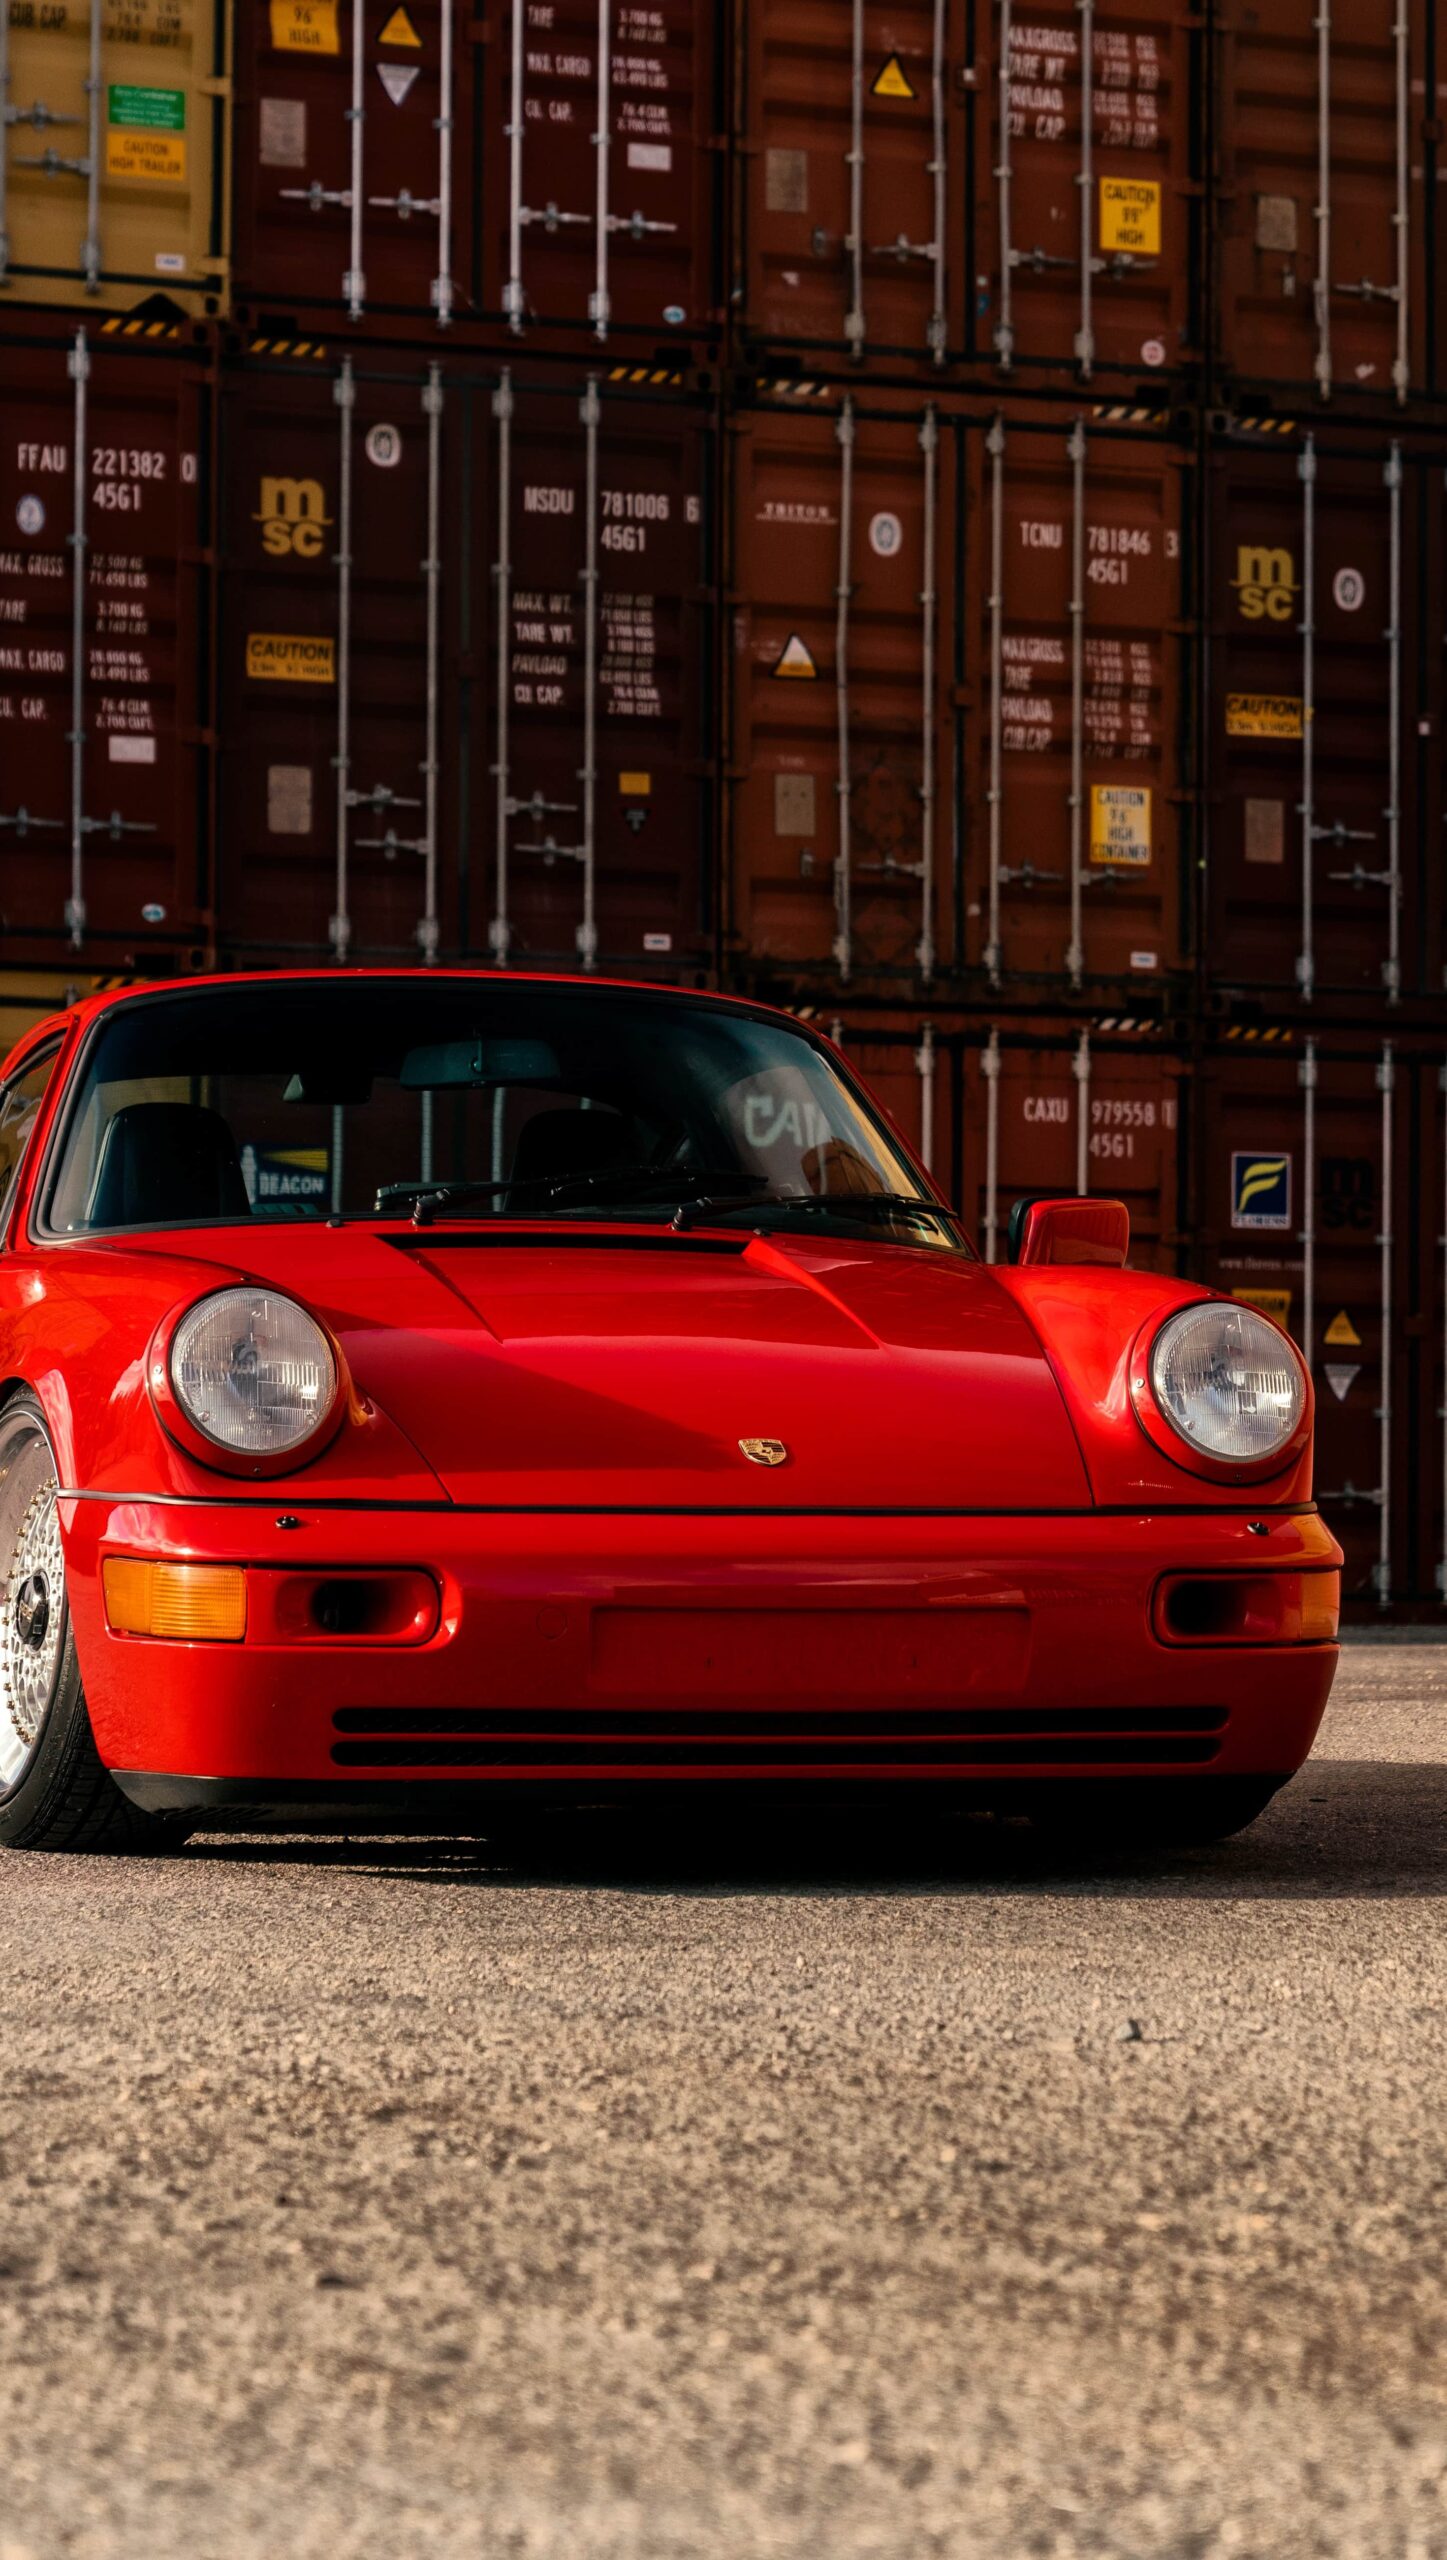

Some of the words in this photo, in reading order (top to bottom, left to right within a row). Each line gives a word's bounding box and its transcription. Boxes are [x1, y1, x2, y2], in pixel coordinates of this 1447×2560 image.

[17, 442, 67, 474] FFAU
[92, 447, 167, 480] 221382
[180, 453, 198, 484] 0
[92, 481, 142, 512] 45G1
[524, 486, 574, 515] MSDU
[600, 490, 670, 521] 781006
[763, 502, 830, 518] TRITON
[600, 525, 647, 552] 45G1
[1020, 521, 1063, 549] TCNU
[1087, 525, 1152, 556] 781846
[27, 554, 64, 577] GROSS
[1086, 557, 1128, 585] 45G1
[90, 569, 126, 587] 71.650
[127, 571, 149, 588] LBS
[128, 619, 149, 635] LBS
[514, 621, 546, 643] TARE
[28, 649, 65, 672] CARGO
[250, 640, 330, 660] CAUTION
[129, 667, 150, 683] LBS
[512, 653, 568, 675] PAYLOAD
[1227, 697, 1299, 717] CAUTION
[1023, 1096, 1069, 1123] CAXU
[1091, 1100, 1156, 1127] 979558
[1089, 1132, 1134, 1159] 45G1
[259, 1171, 325, 1196] BEACON
